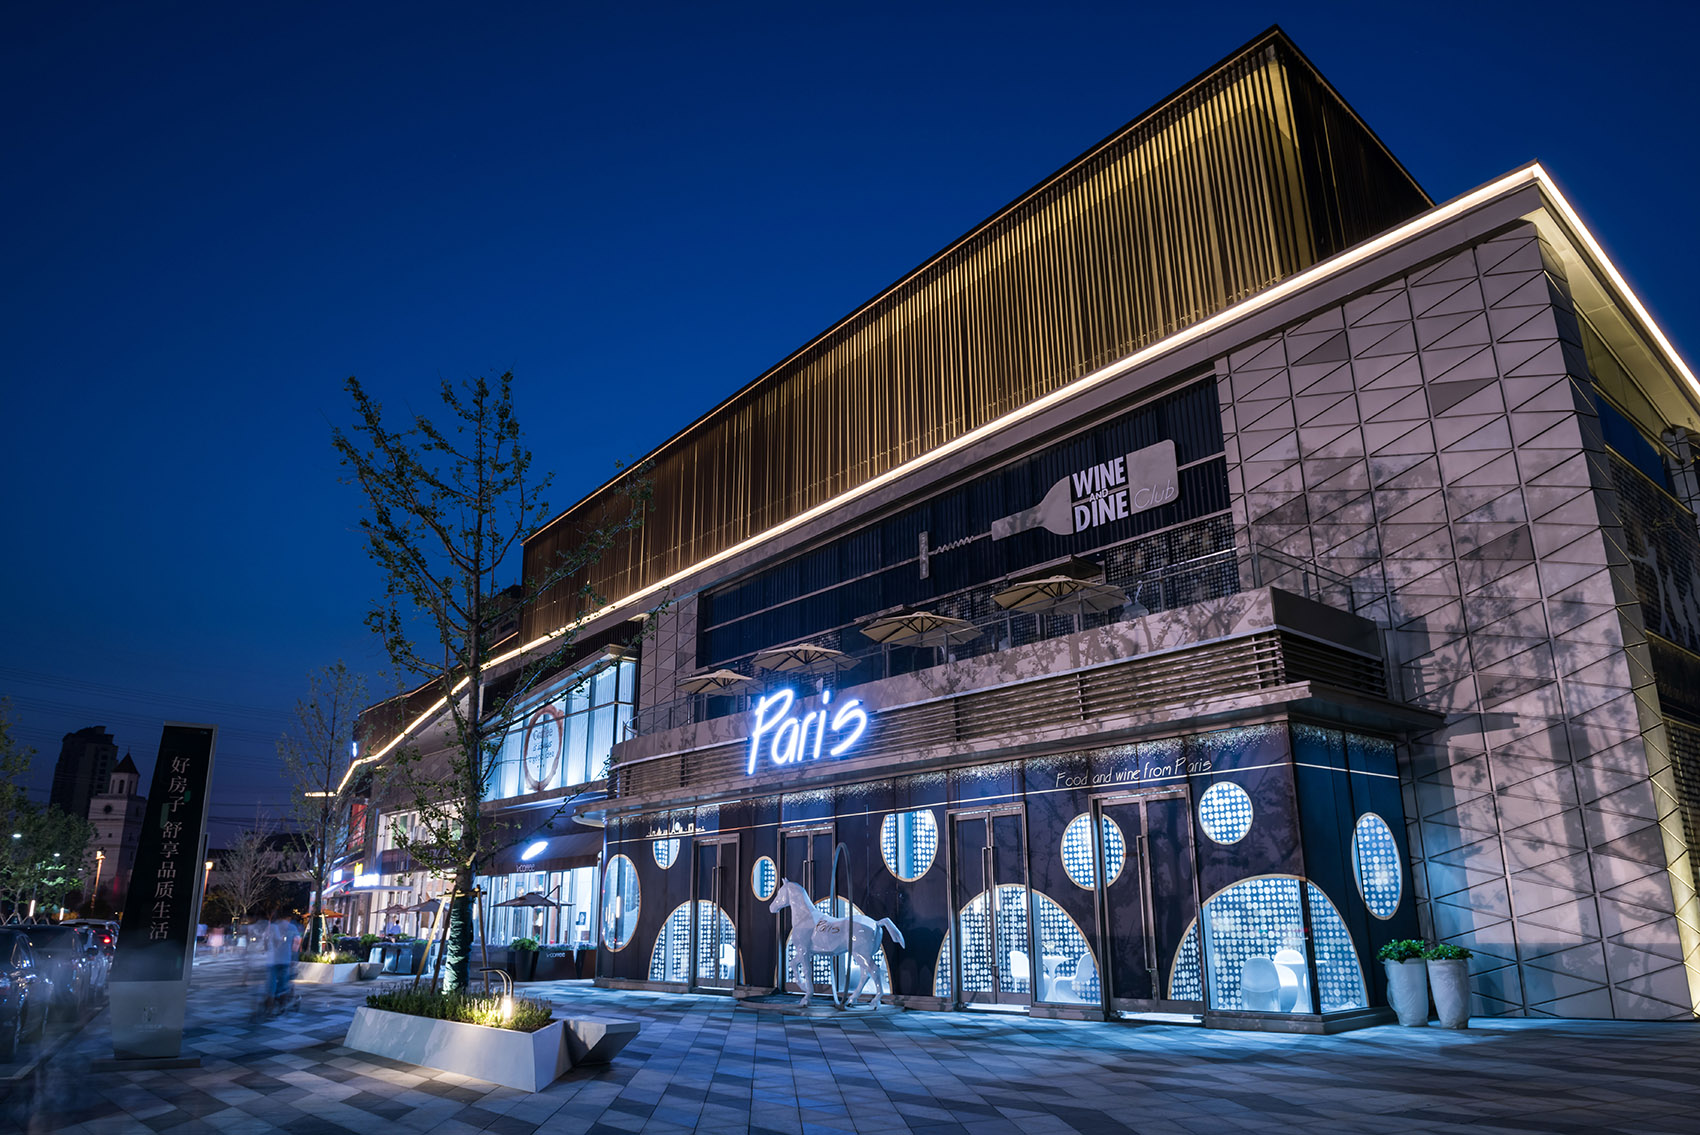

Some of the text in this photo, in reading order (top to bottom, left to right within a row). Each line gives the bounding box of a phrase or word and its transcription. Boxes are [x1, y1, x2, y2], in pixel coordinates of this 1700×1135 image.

[1072, 456, 1125, 498] WINE
[1089, 488, 1109, 502] AND
[1134, 480, 1175, 509] Club
[1075, 490, 1129, 533] DINE
[748, 688, 868, 775] Paris
[1055, 757, 1212, 788] Food and wine from Paris
[149, 756, 191, 941] 好房子 舒享品质生活
